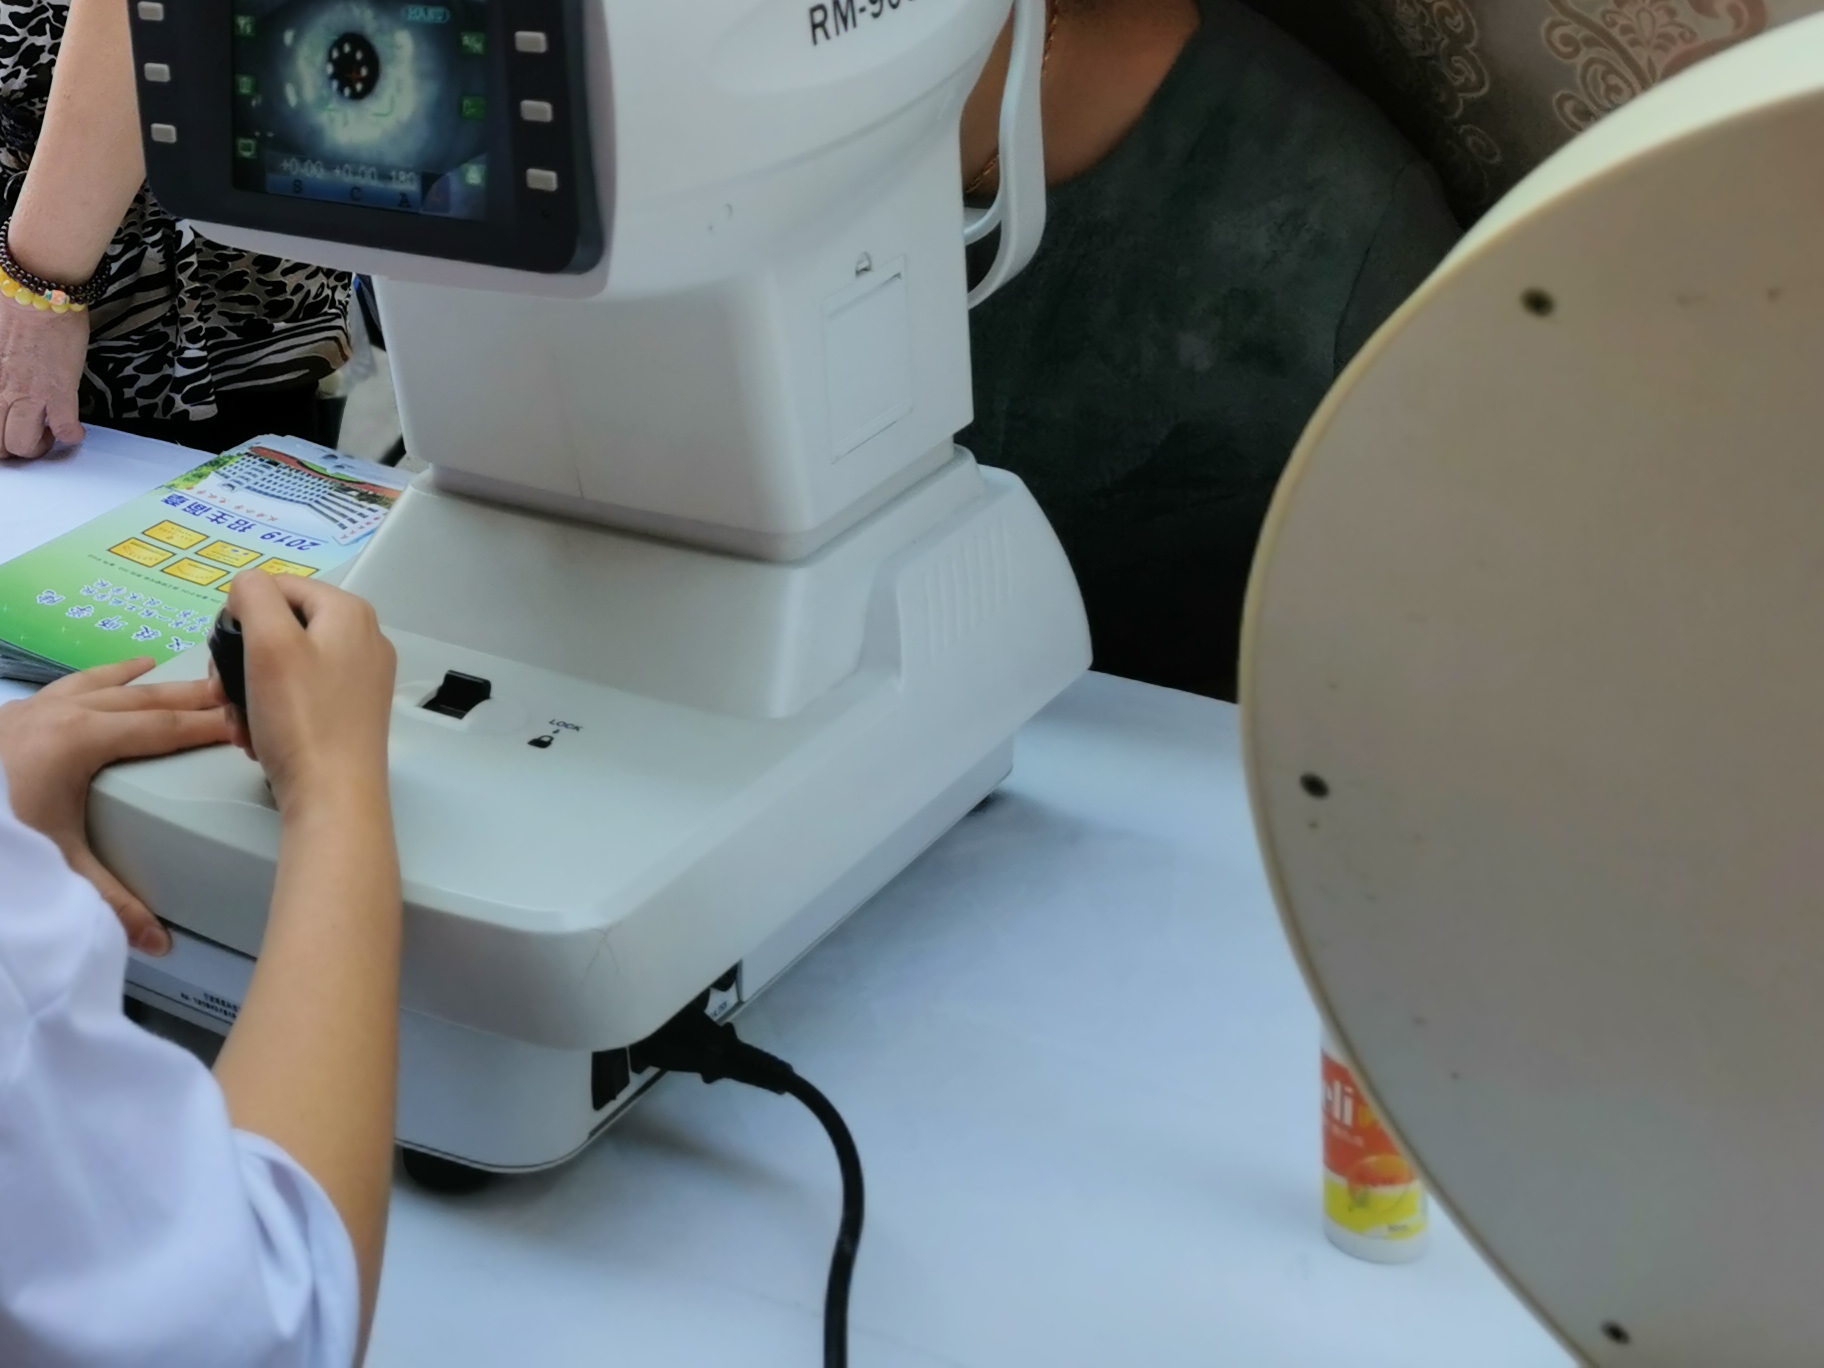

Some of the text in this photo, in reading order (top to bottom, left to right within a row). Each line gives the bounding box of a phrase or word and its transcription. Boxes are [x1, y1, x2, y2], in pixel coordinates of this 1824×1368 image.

[161, 492, 258, 534] 招生简章
[259, 531, 322, 552] 2019
[548, 718, 583, 732] LOCK
